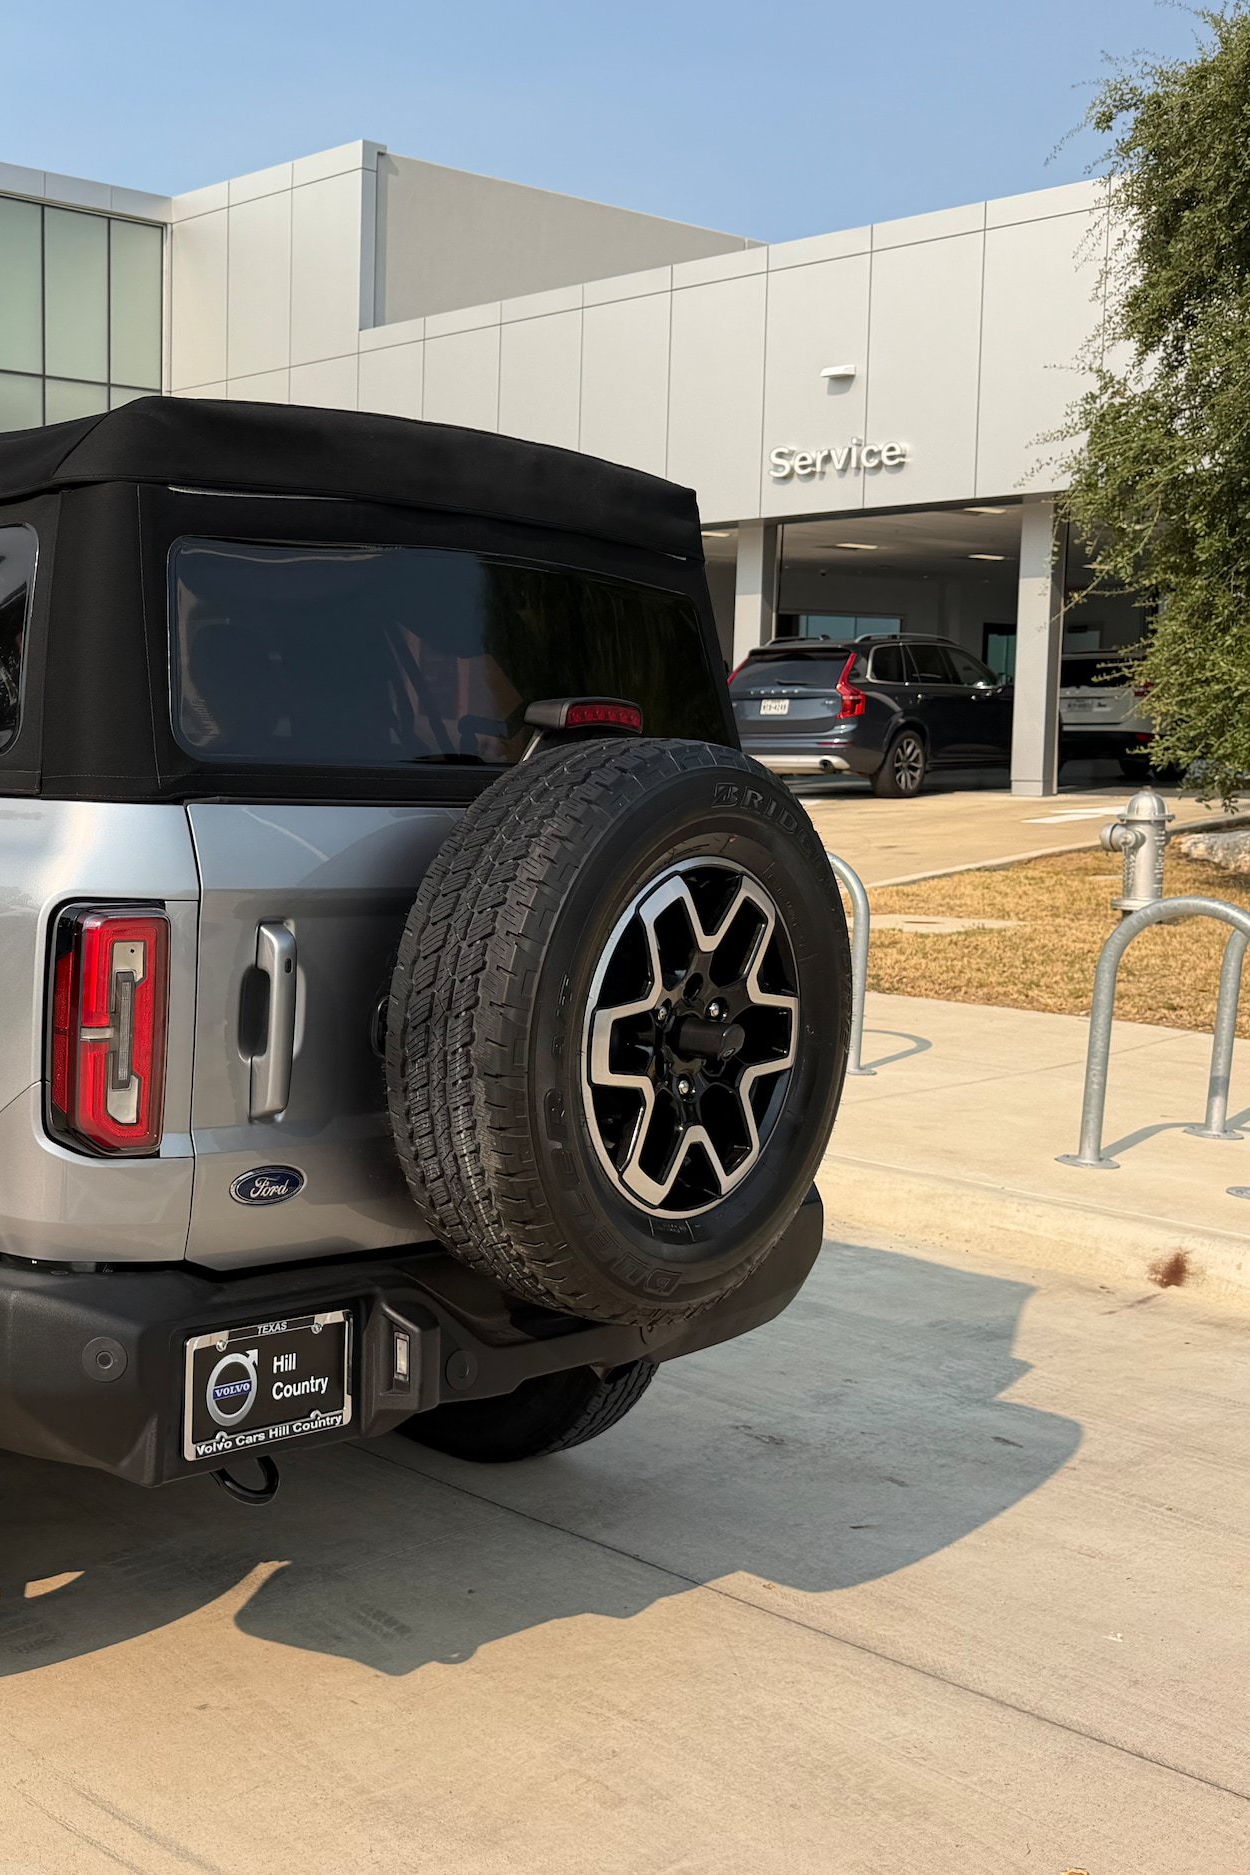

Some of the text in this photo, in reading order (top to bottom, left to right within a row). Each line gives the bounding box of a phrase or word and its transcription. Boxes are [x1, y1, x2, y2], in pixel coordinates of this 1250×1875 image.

[768, 436, 902, 478] Service
[250, 1176, 290, 1198] Ford
[257, 1321, 288, 1336] TEXAS
[272, 1353, 297, 1374] Hill
[214, 1382, 250, 1398] VOLVO
[272, 1375, 329, 1400] Country
[196, 1414, 342, 1456] Volvo Cars Hill Country
